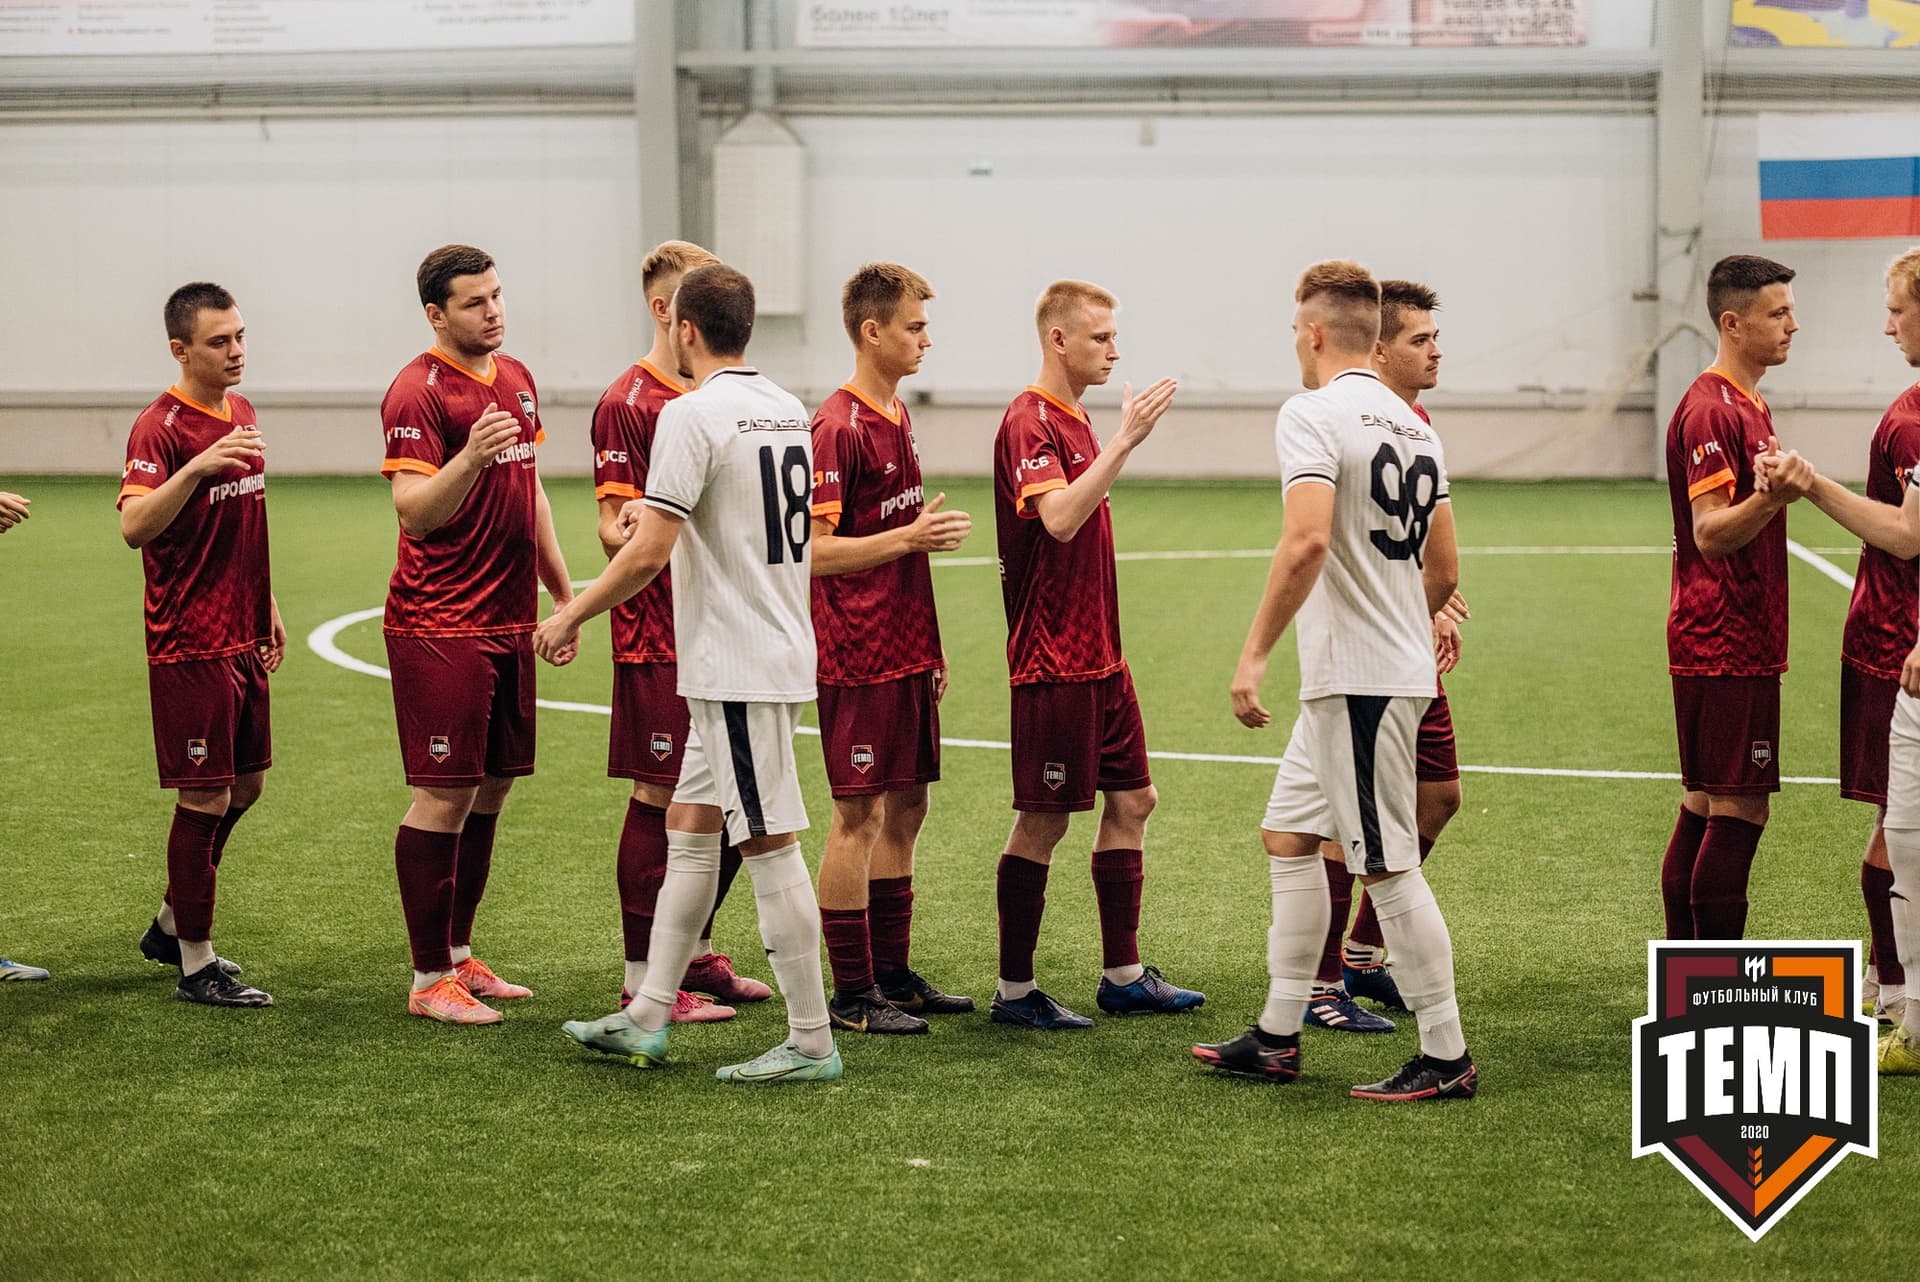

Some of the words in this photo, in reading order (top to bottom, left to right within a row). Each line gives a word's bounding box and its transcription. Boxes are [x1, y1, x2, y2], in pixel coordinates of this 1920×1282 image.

[394, 427, 421, 440] ПСБ
[1705, 440, 1722, 455] ПС
[131, 459, 158, 474] ПСБ
[1021, 456, 1049, 471] ПСБ
[825, 471, 840, 484] ПС
[758, 445, 812, 564] 18
[1369, 442, 1439, 570] 98
[653, 740, 671, 752] ТЕМП
[854, 752, 872, 764] ТЕМП
